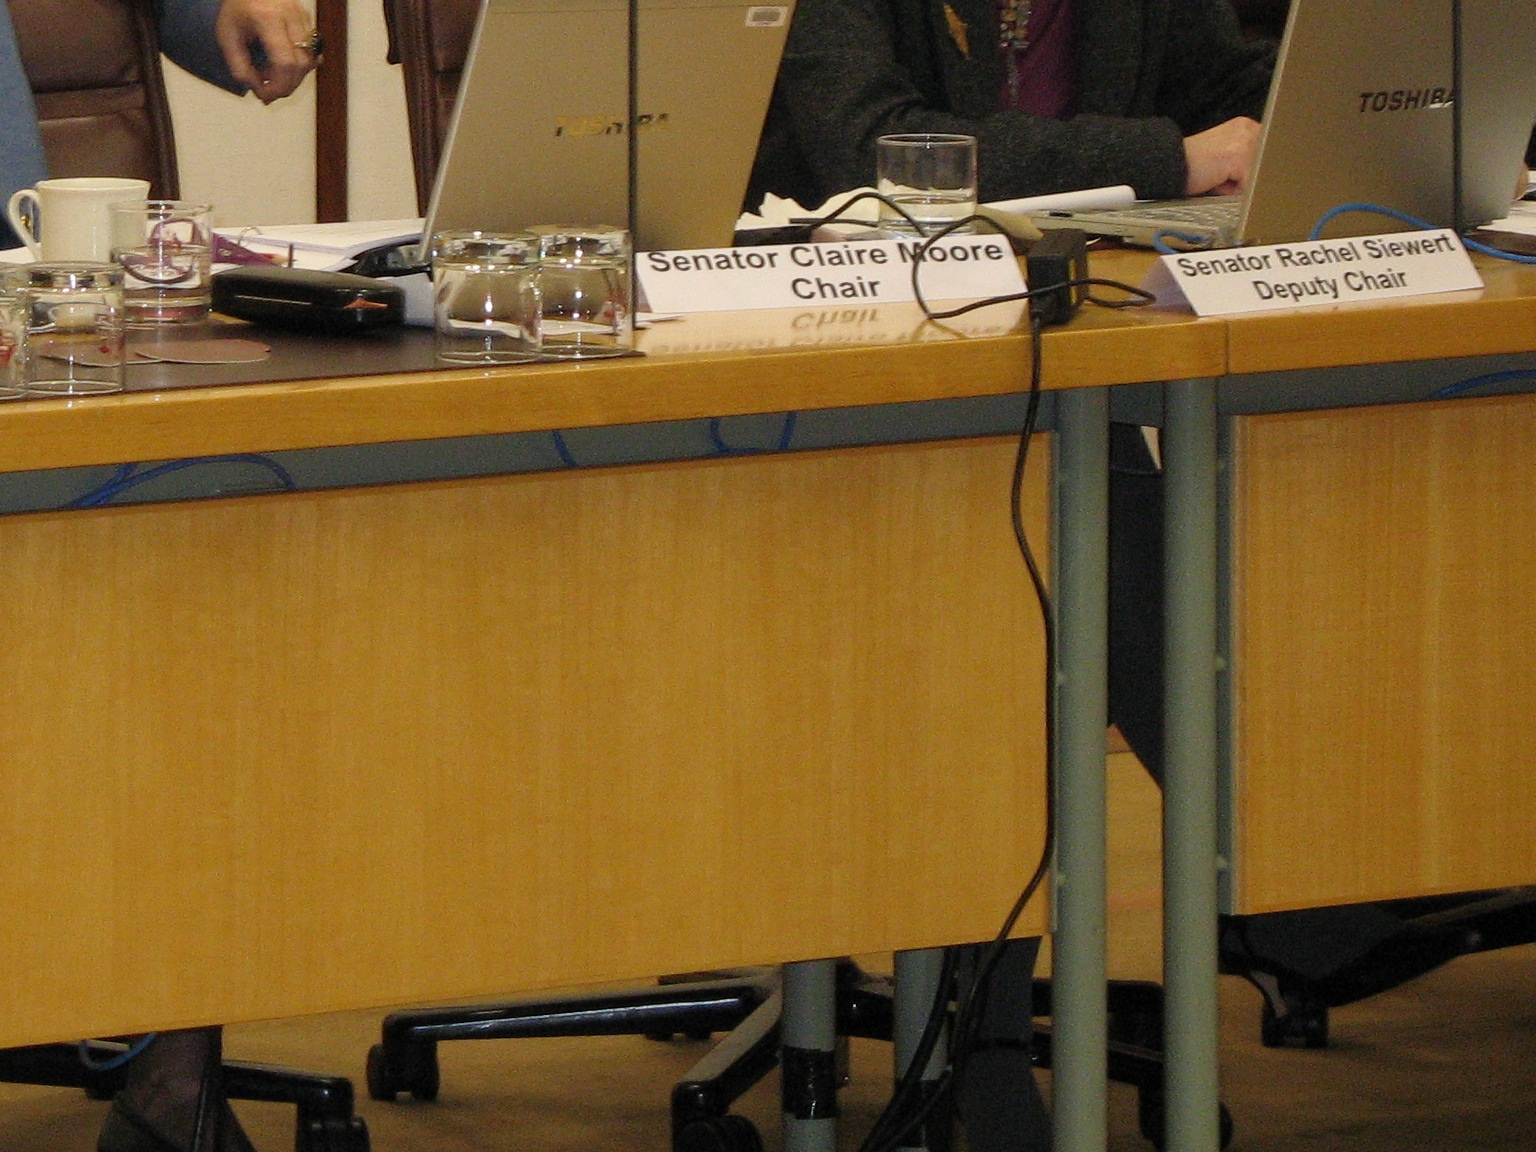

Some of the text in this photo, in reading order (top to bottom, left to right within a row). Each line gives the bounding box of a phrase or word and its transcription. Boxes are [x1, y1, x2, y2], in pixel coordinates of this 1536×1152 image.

[554, 113, 670, 137] TOSHBA
[647, 241, 1005, 273] Senator Claire Moore
[1177, 233, 1456, 277] Senator Rachel Siewert
[791, 276, 881, 299] Chair
[1251, 268, 1407, 303] Deputy Chair
